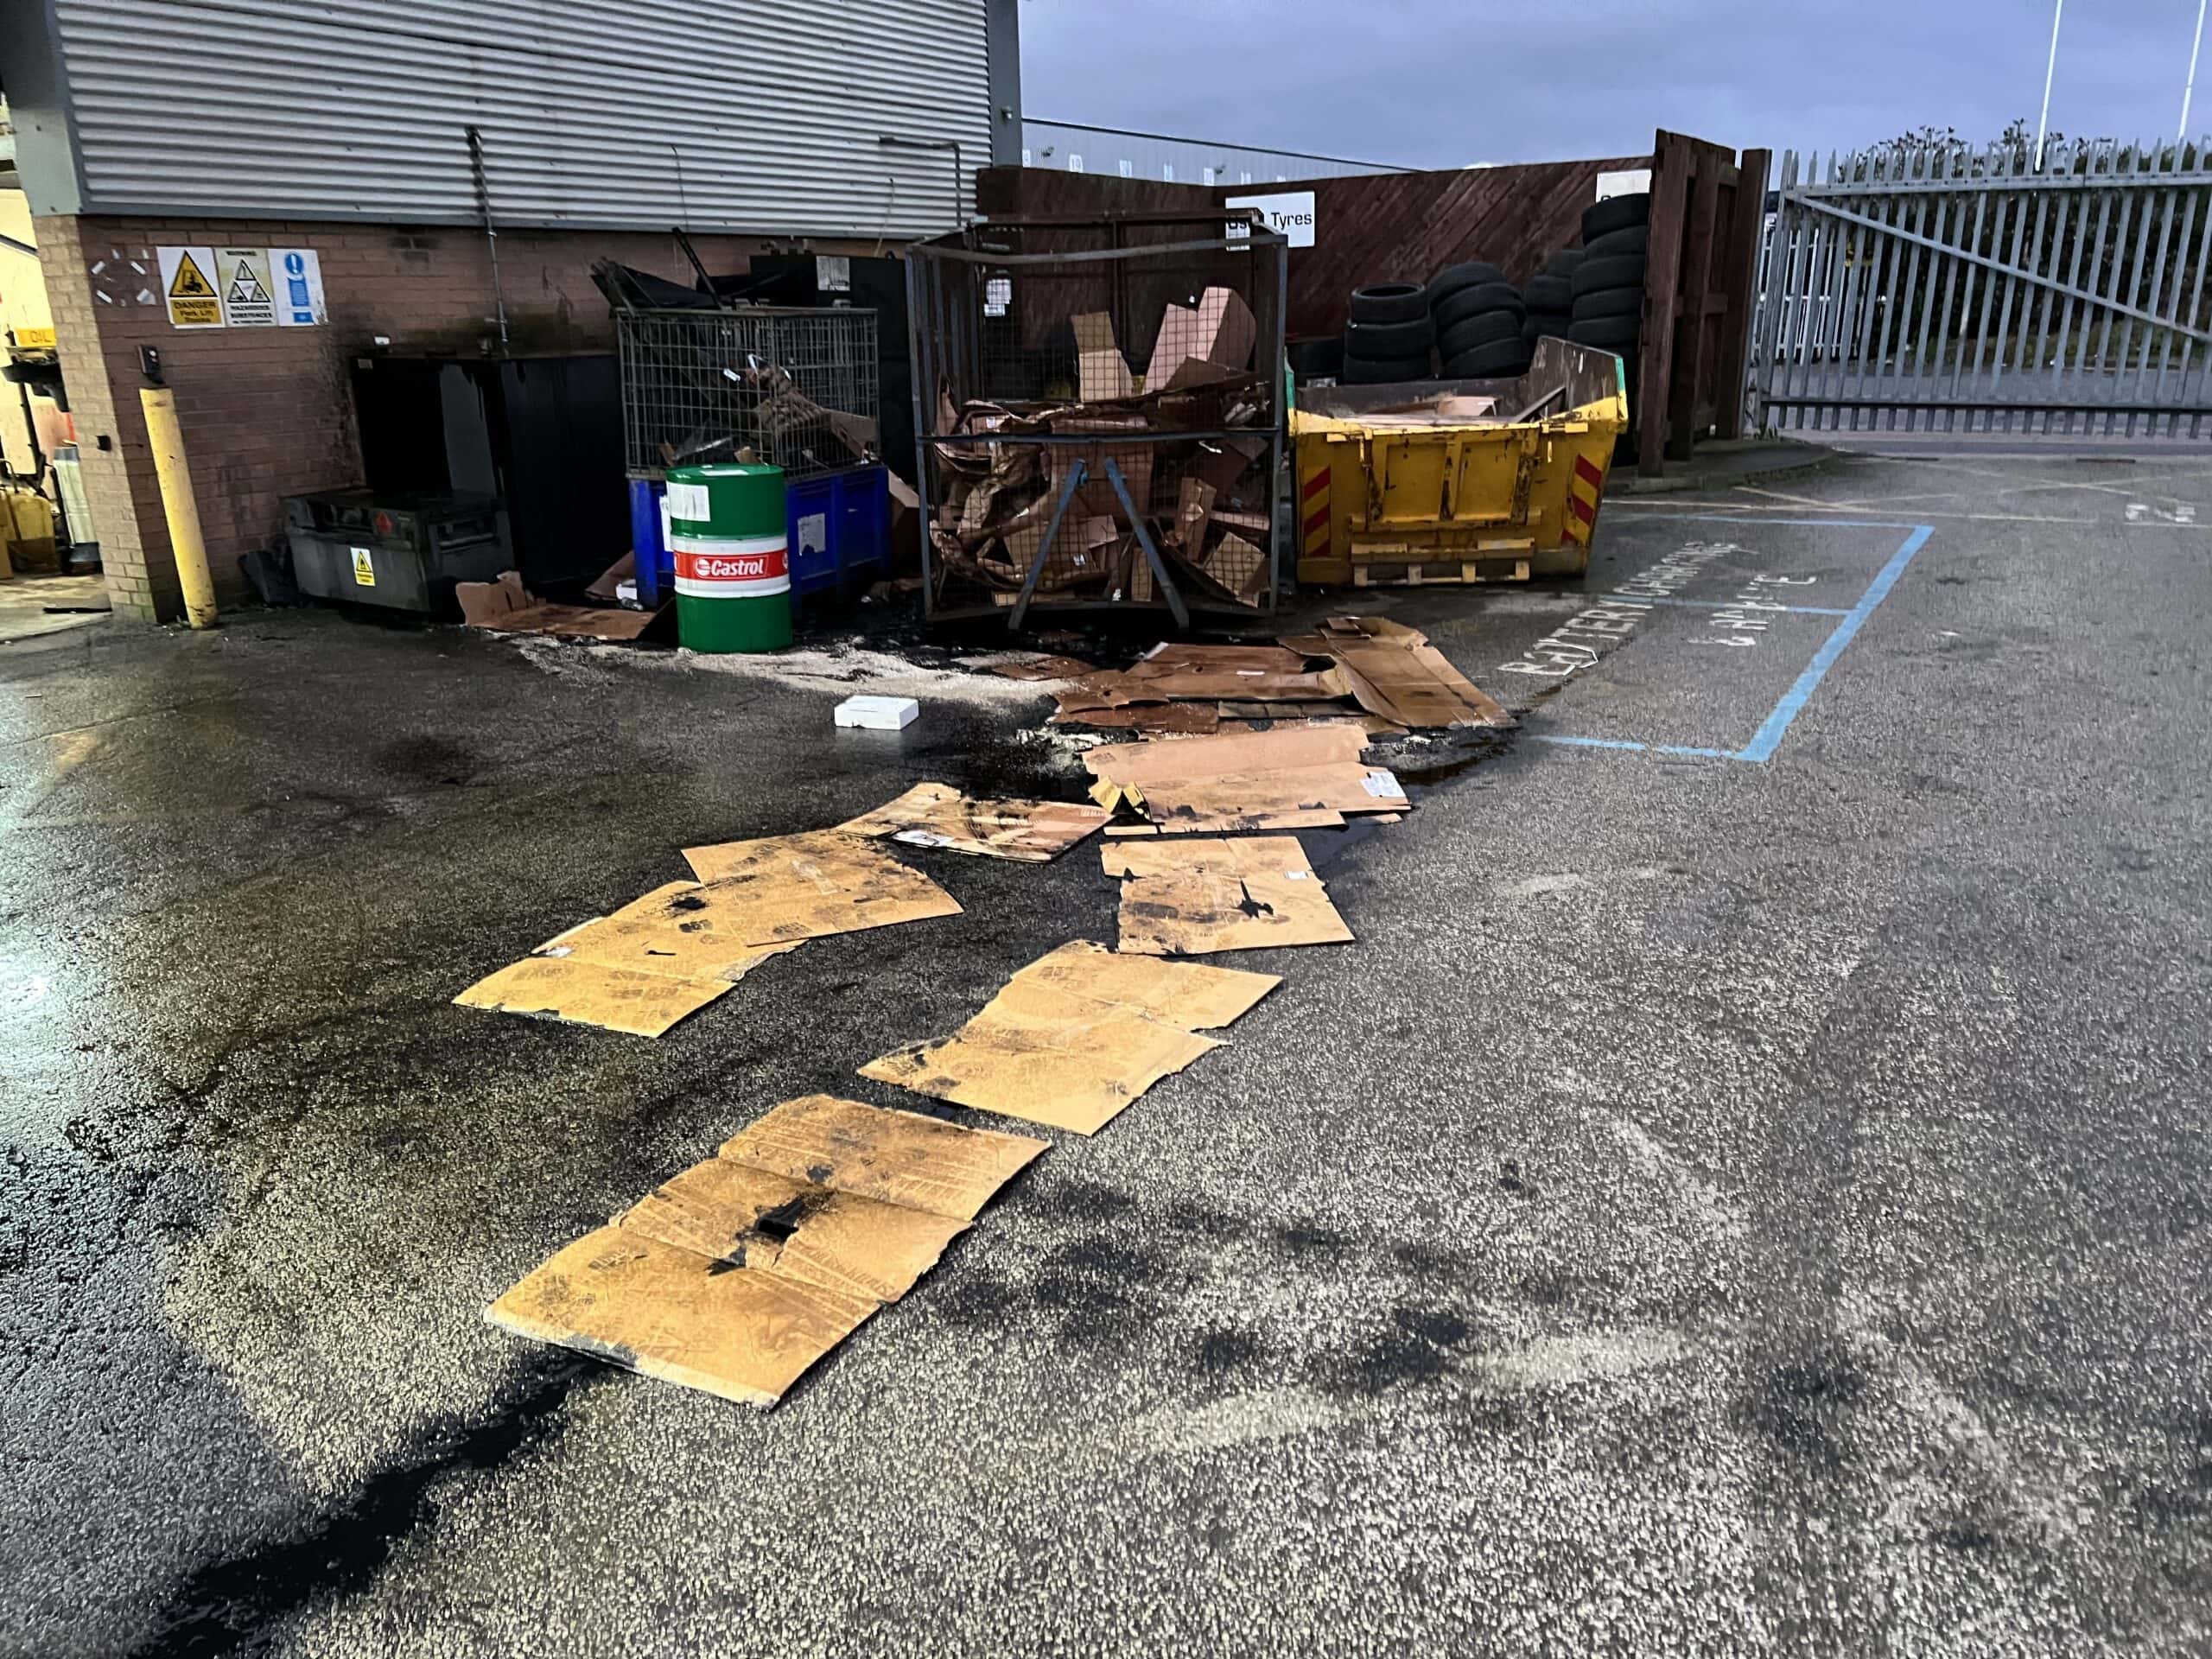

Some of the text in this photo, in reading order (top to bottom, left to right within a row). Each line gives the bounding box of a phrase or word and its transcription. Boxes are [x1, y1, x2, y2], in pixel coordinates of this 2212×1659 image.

[1271, 212, 1313, 230] Tyres
[173, 301, 217, 309] DANGER
[710, 558, 765, 577] Castrol
